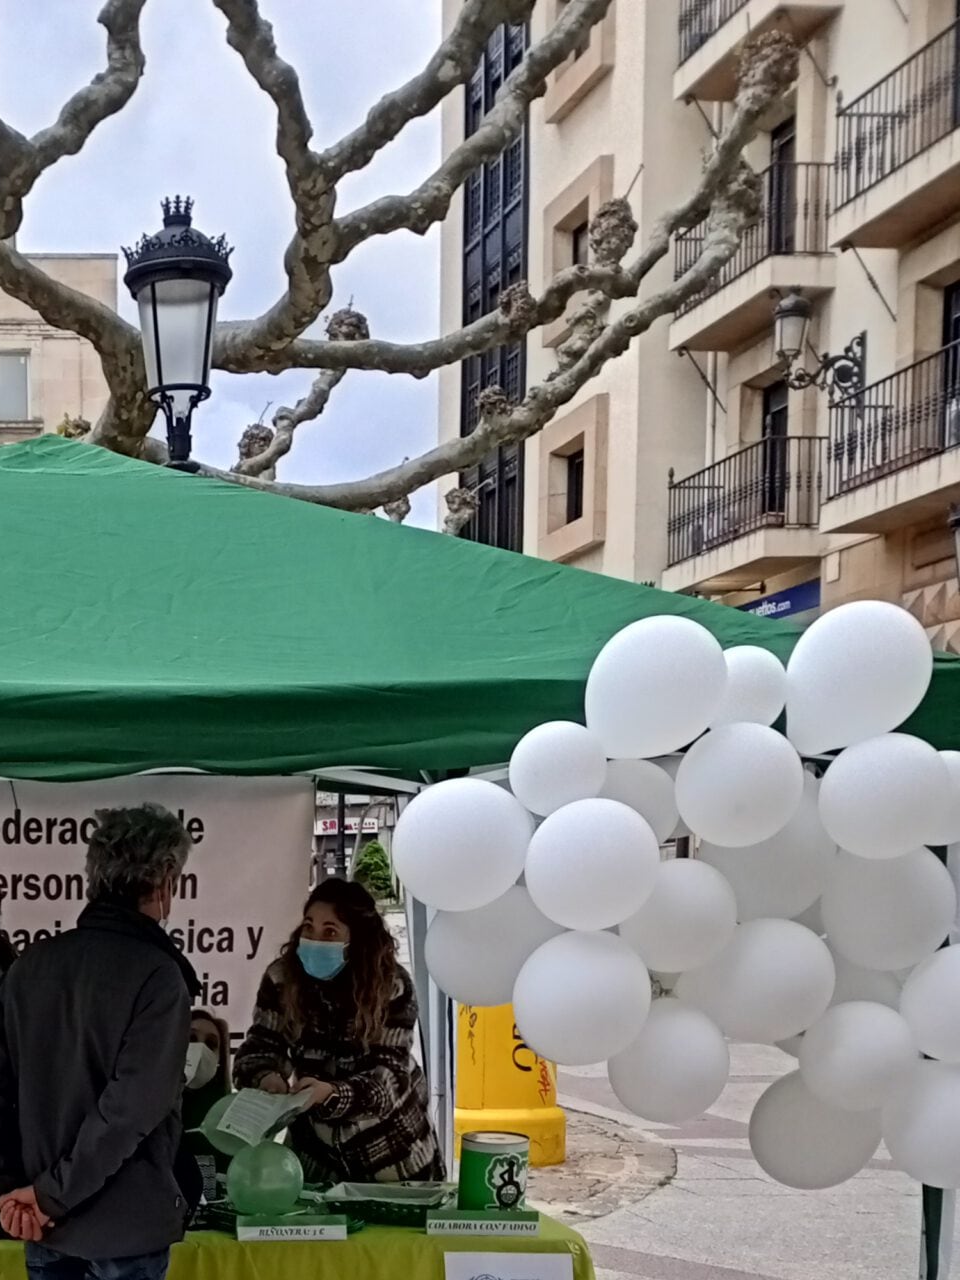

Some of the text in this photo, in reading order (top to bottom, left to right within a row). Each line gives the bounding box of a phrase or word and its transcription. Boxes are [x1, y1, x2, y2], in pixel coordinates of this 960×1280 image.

[178, 809, 205, 845] e
[170, 919, 264, 960] sica y
[428, 1222, 477, 1231] COLABORA
[479, 1222, 501, 1232] CON
